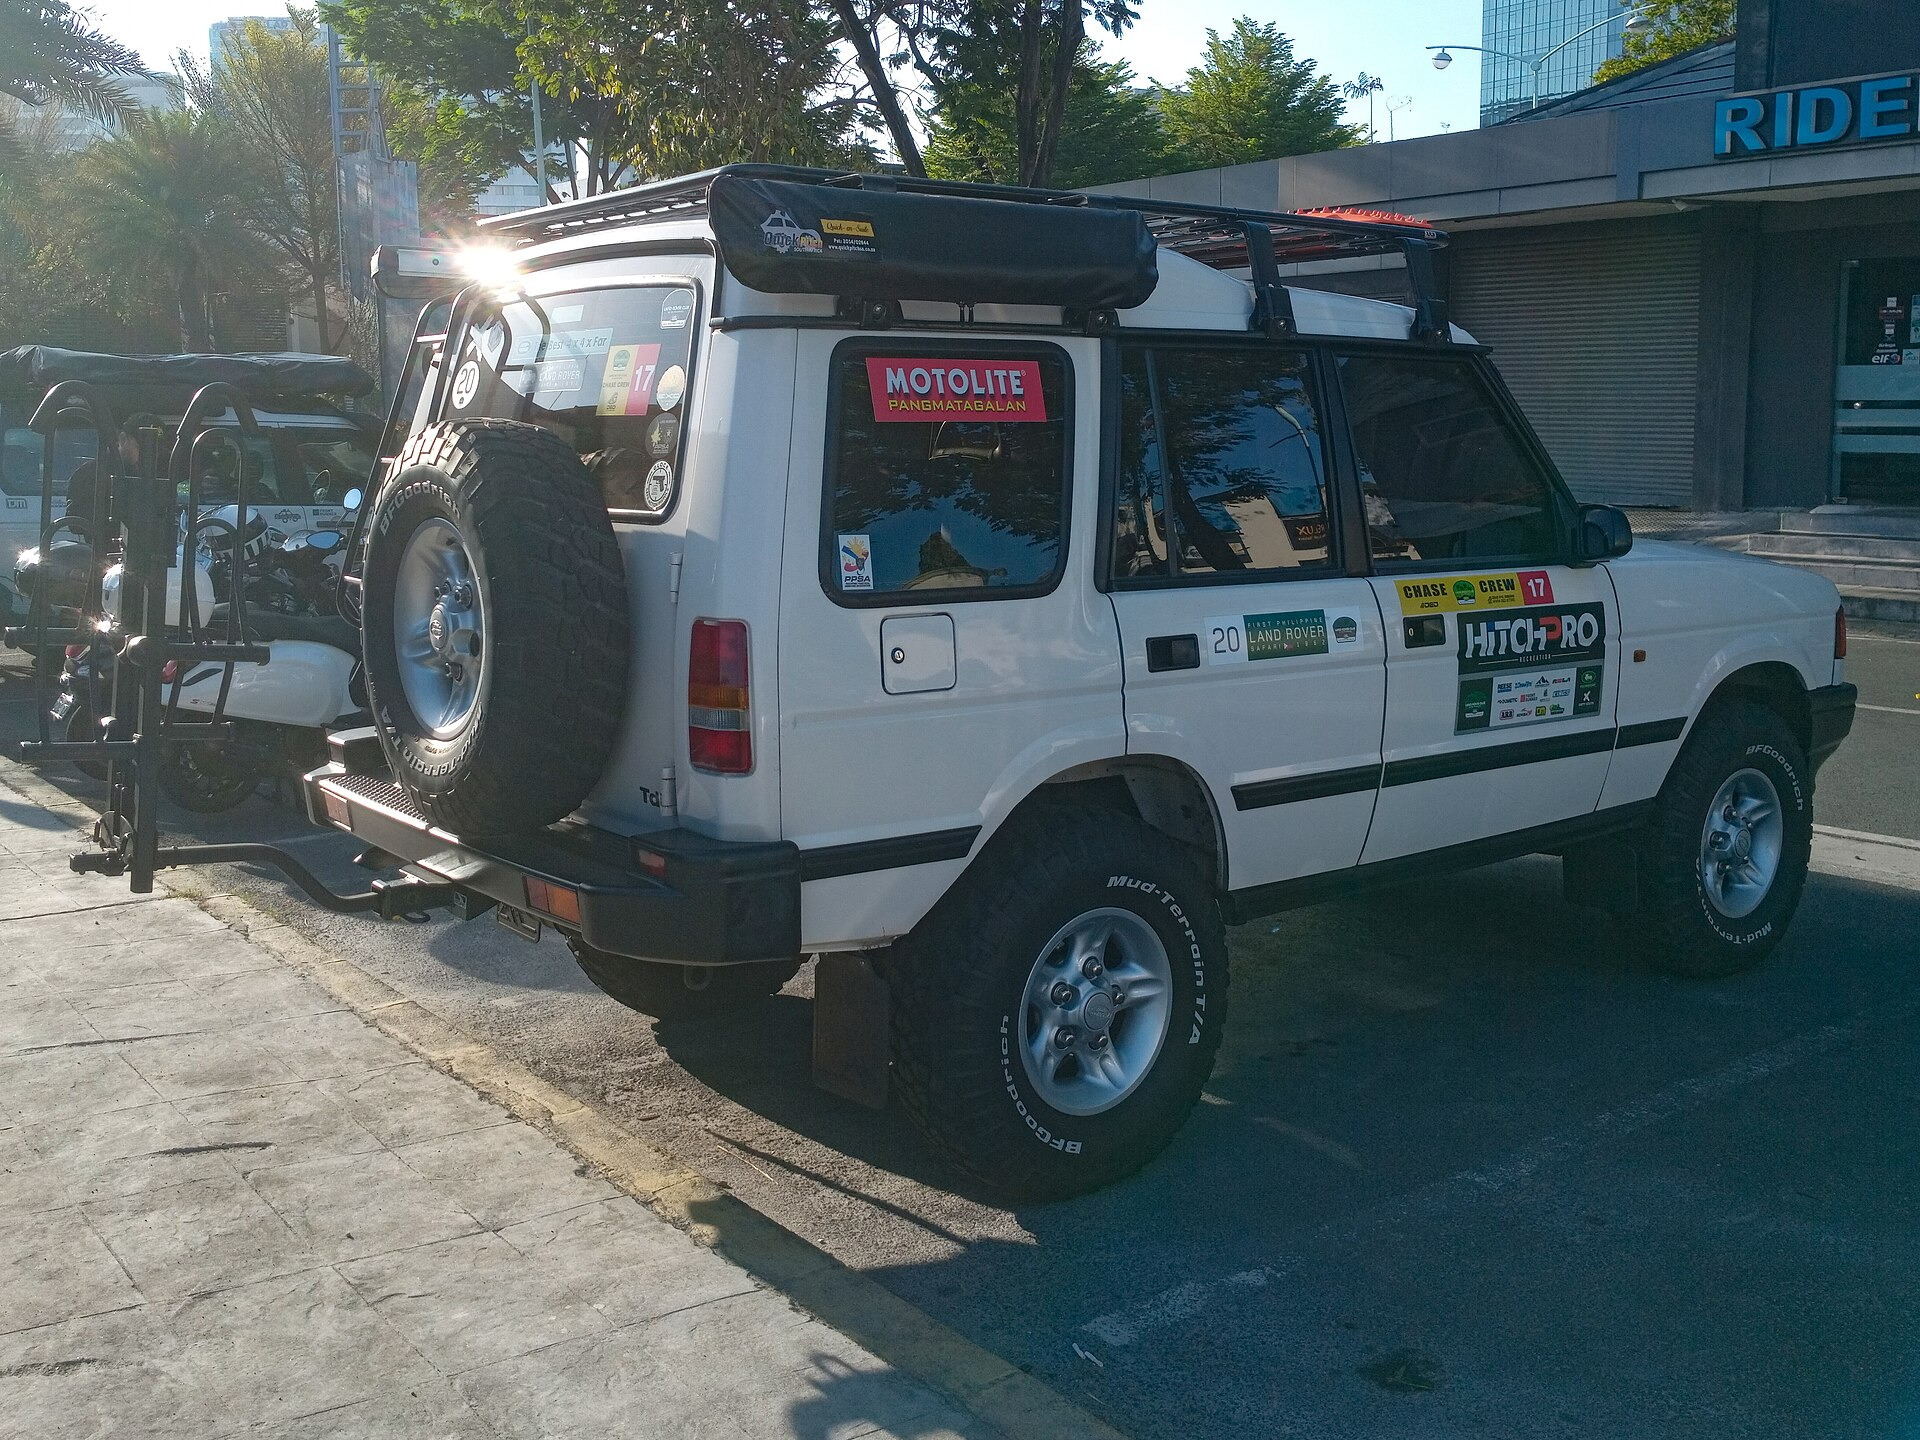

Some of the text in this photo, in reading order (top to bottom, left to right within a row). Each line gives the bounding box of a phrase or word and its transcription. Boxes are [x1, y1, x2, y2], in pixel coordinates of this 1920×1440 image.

[1714, 77, 1920, 155] RIDE
[593, 335, 608, 347] Far
[1872, 354, 1890, 364] elf
[456, 367, 476, 394] 20
[634, 364, 656, 392] 17
[886, 367, 1025, 397] MOTOLITE
[888, 399, 1027, 412] PANGMATAGALAN
[380, 480, 460, 536] BFGoodrich
[844, 575, 871, 583] PPSA
[1402, 578, 1545, 599] CHASE CREW 17
[1247, 616, 1323, 628] FIRST PHILIPPINE
[1249, 629, 1282, 643] LAND
[1286, 625, 1325, 640] ROVER
[1211, 626, 1240, 654] 20
[1250, 643, 1281, 652] SAFARI
[1519, 653, 1552, 663] RECREATION
[1745, 743, 1804, 812] BFGoodrich
[639, 786, 662, 808] Td
[1701, 897, 1773, 945] Mud-Terrain
[1106, 874, 1207, 1045] Mud-Terrain T/A
[1000, 1014, 1083, 1155] BFGoodrich
